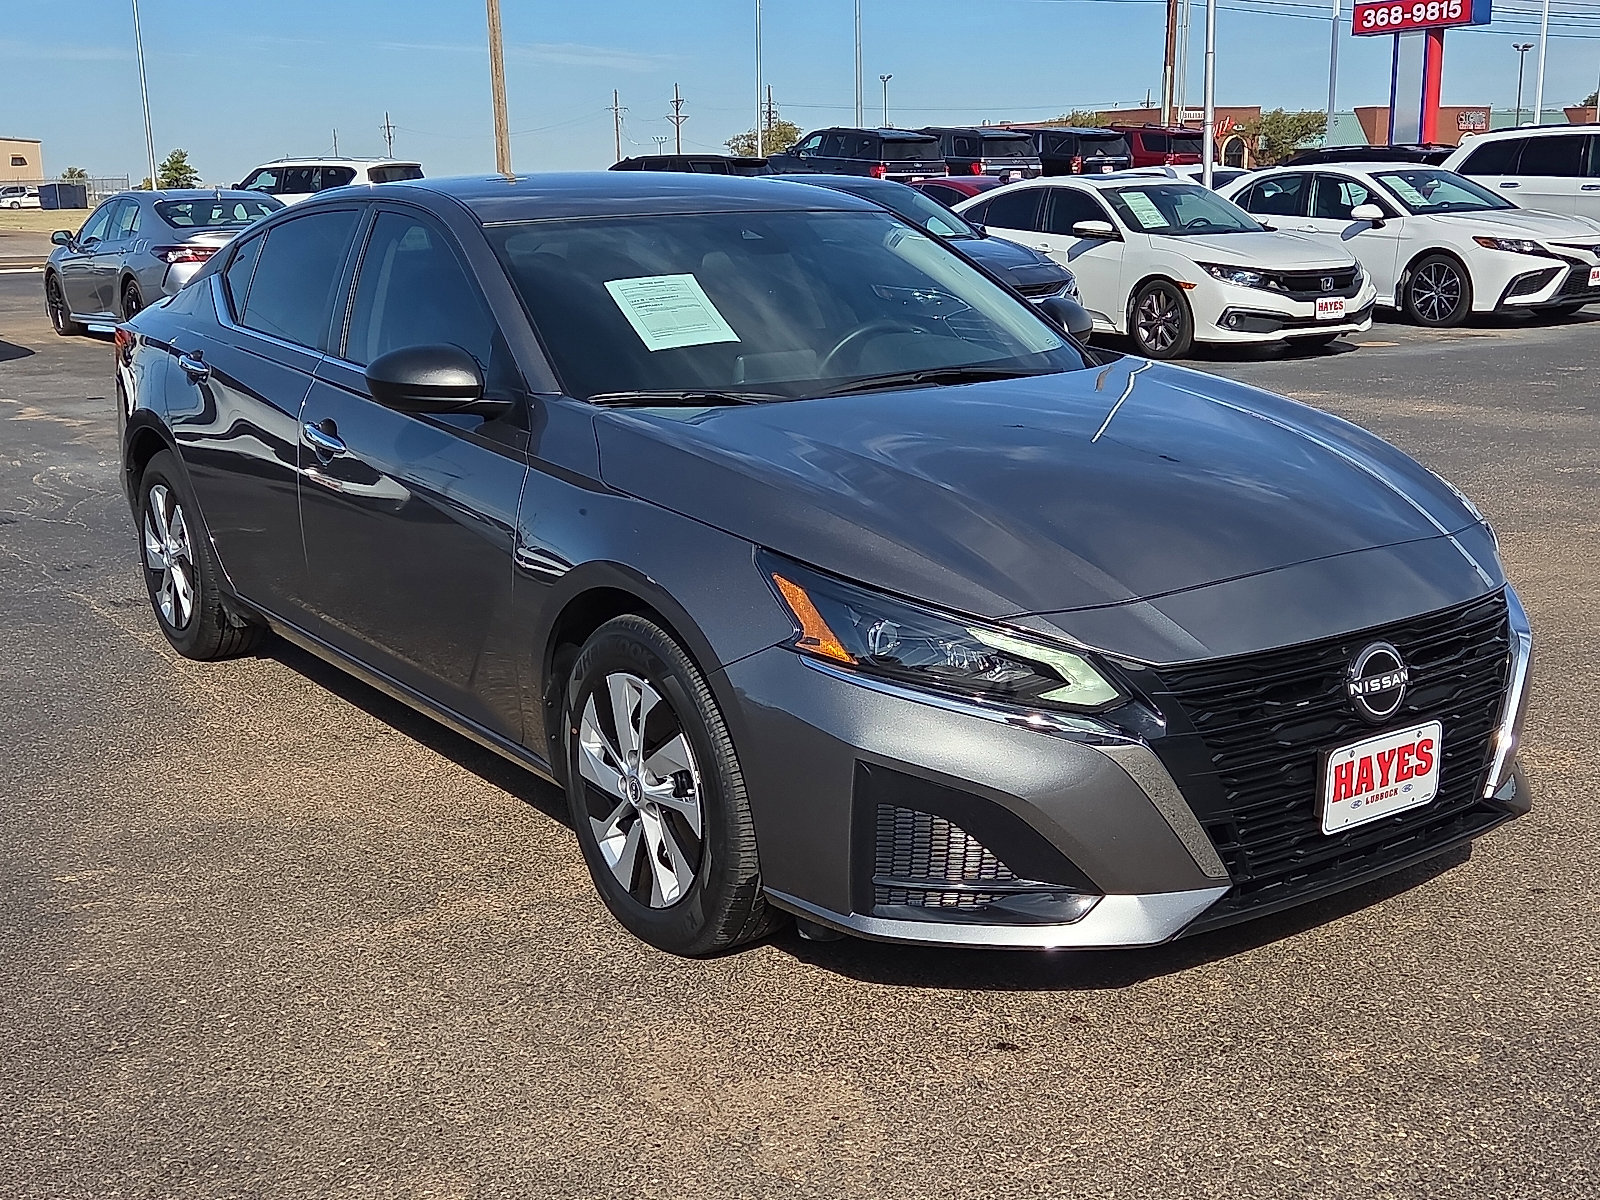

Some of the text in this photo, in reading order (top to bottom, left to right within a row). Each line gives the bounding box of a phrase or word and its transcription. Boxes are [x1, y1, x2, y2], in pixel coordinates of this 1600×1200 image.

[1362, 0, 1462, 28] 368-9815
[1318, 301, 1343, 311] HAYES
[1349, 670, 1409, 696] NISSAN
[1332, 738, 1434, 804] HAYES
[1365, 787, 1399, 805] LUBBOCK
